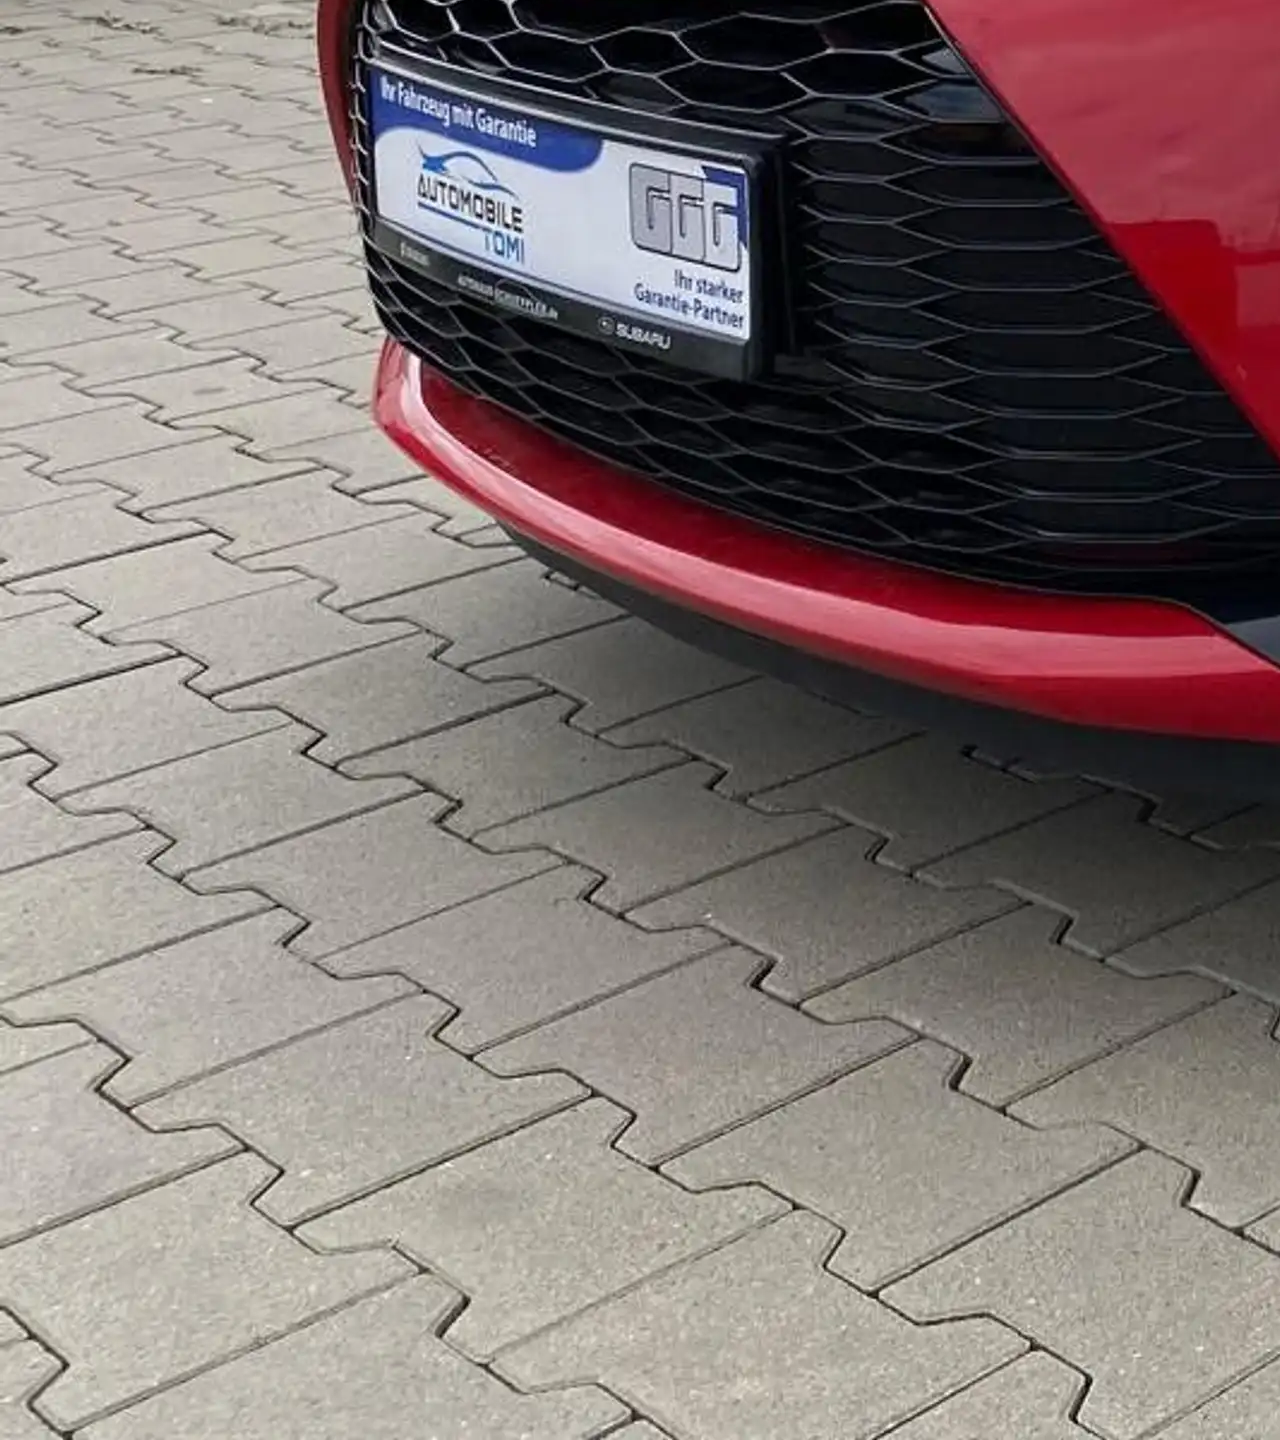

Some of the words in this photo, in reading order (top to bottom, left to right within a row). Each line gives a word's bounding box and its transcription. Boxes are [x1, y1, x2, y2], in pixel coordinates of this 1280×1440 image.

[380, 75, 397, 103] Ihr
[398, 81, 450, 128] Fahrzeug
[452, 103, 475, 129] mit
[475, 107, 537, 148] Garantie
[417, 172, 524, 234] AUTOMOBILE
[483, 230, 525, 265] TOMI
[633, 282, 744, 329] Garantie-Partner
[673, 269, 693, 291] Ihr
[695, 278, 744, 304] starker
[615, 322, 672, 350] SUBARU
